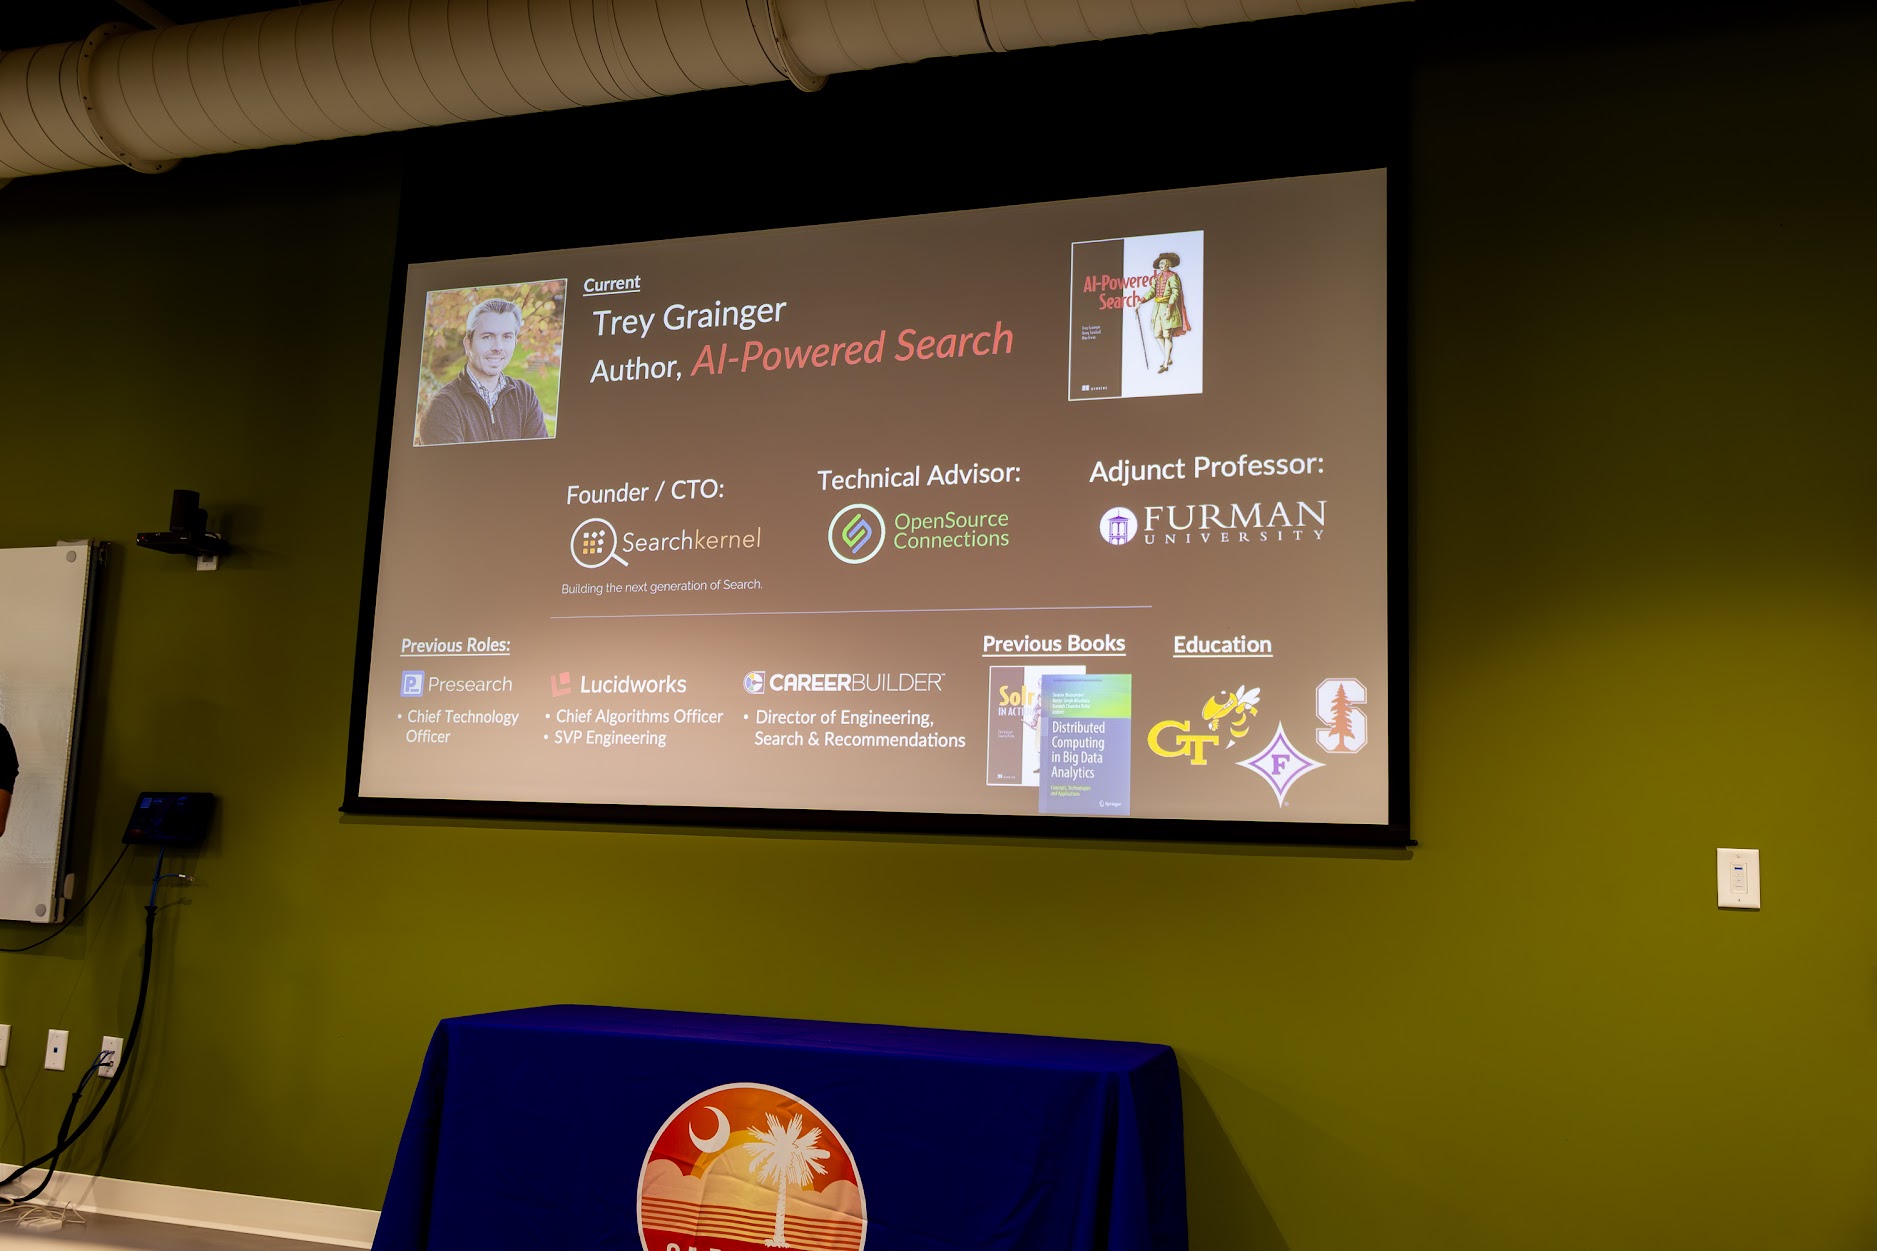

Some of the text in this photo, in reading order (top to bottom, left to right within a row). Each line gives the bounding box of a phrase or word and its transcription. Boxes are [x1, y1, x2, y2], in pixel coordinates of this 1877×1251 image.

[583, 275, 641, 294] Current
[593, 300, 787, 338] Trey Grainger
[590, 321, 1014, 384] Author, AI-Powered Search
[817, 463, 1021, 491] Technical Advisor:
[1089, 454, 1324, 486] Adjunct Professor:
[567, 478, 724, 504] Founder / CTO:
[894, 511, 1009, 533] OpenSource
[1144, 501, 1328, 532] FURMAN
[622, 526, 761, 553] Searchkernel
[893, 530, 1010, 549] Connections
[1144, 529, 1324, 545] UNIVERSITY
[561, 578, 763, 595] Building the next generation of Search.
[401, 637, 511, 653] Previous Roles:
[983, 634, 1126, 652] Previous Books
[1173, 635, 1272, 653] Education
[428, 676, 512, 692] Presearch
[580, 675, 687, 694] Lucidworks
[769, 673, 943, 692] CAREERBUILDER
[999, 685, 1035, 706] Solr
[407, 710, 519, 726] Chief Technology
[556, 709, 724, 726] Chief Algorithms Officer
[756, 709, 934, 728] Director of Engineering,
[998, 707, 1032, 717] IN ACTI
[405, 729, 451, 743] Officer
[1052, 721, 1105, 734] Distributed
[554, 730, 667, 748] SVP Engineering
[754, 731, 966, 748] Search & Recommendations
[1052, 736, 1105, 751] Computing
[1051, 751, 1103, 766] in Big Data
[1271, 754, 1290, 776] F
[1051, 766, 1095, 781] Analytics
